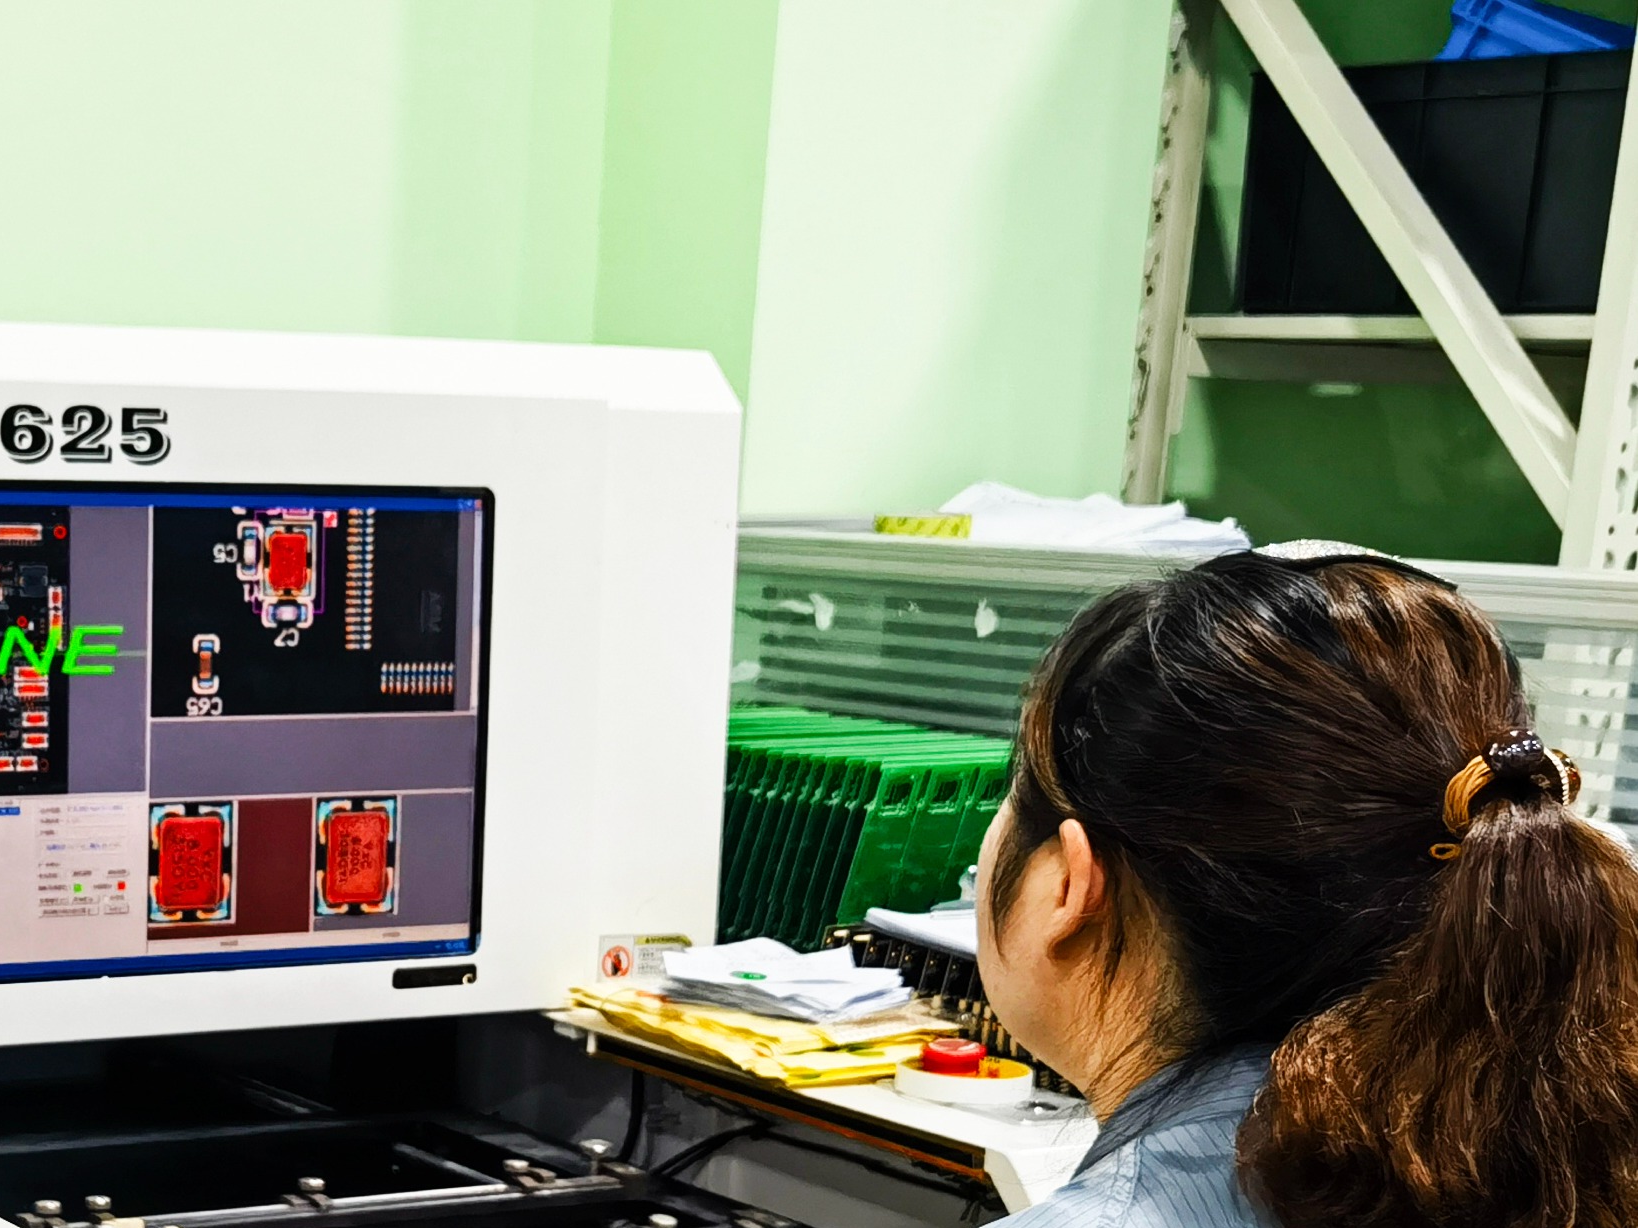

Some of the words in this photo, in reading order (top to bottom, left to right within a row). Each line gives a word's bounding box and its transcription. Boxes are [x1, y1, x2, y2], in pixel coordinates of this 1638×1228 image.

[212, 543, 239, 563] C5
[273, 628, 300, 647] C7
[185, 696, 223, 716] C65
